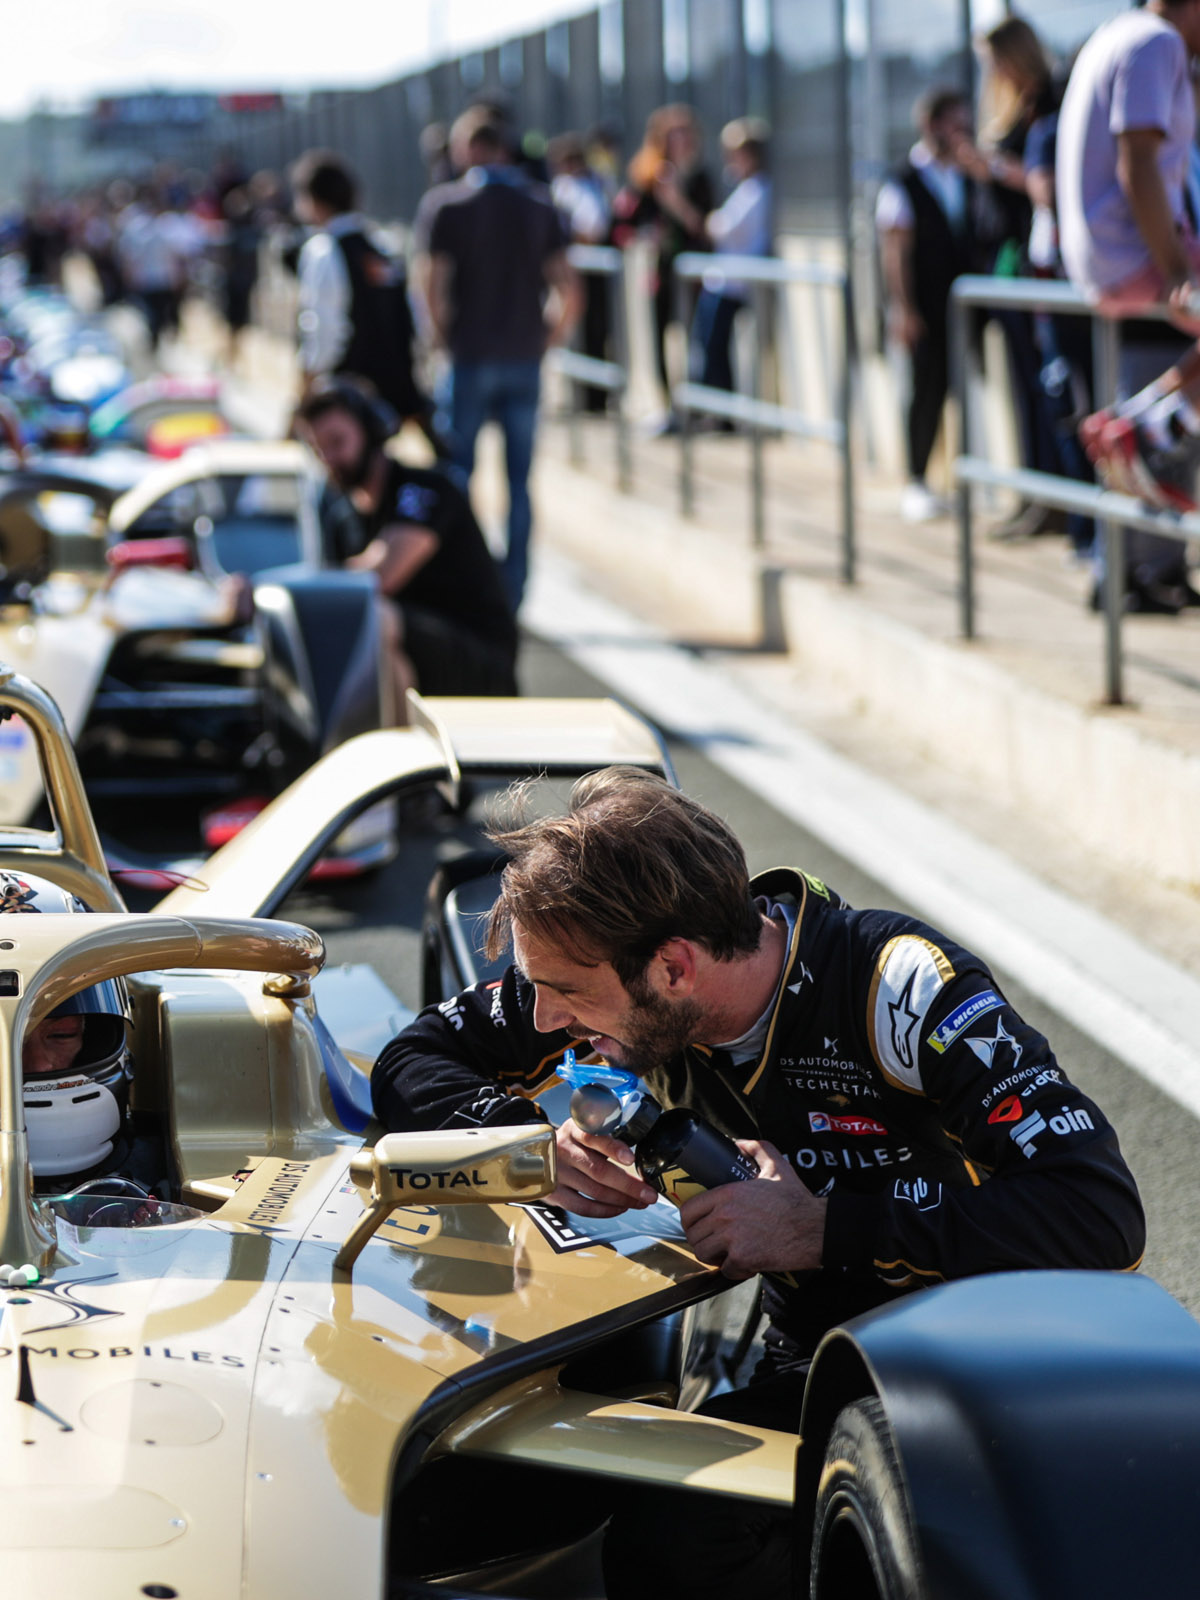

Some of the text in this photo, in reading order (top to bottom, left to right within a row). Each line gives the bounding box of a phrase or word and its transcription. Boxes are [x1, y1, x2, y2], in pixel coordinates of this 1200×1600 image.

[952, 995, 998, 1029] MICHELIN
[780, 1057, 795, 1067] DS
[798, 1056, 873, 1080] AUTOMOBIS
[981, 1092, 993, 1108] DS
[830, 1118, 884, 1132] TOTAL
[389, 1168, 488, 1190] TOTAL
[247, 1173, 304, 1223] AUTOMOBILES
